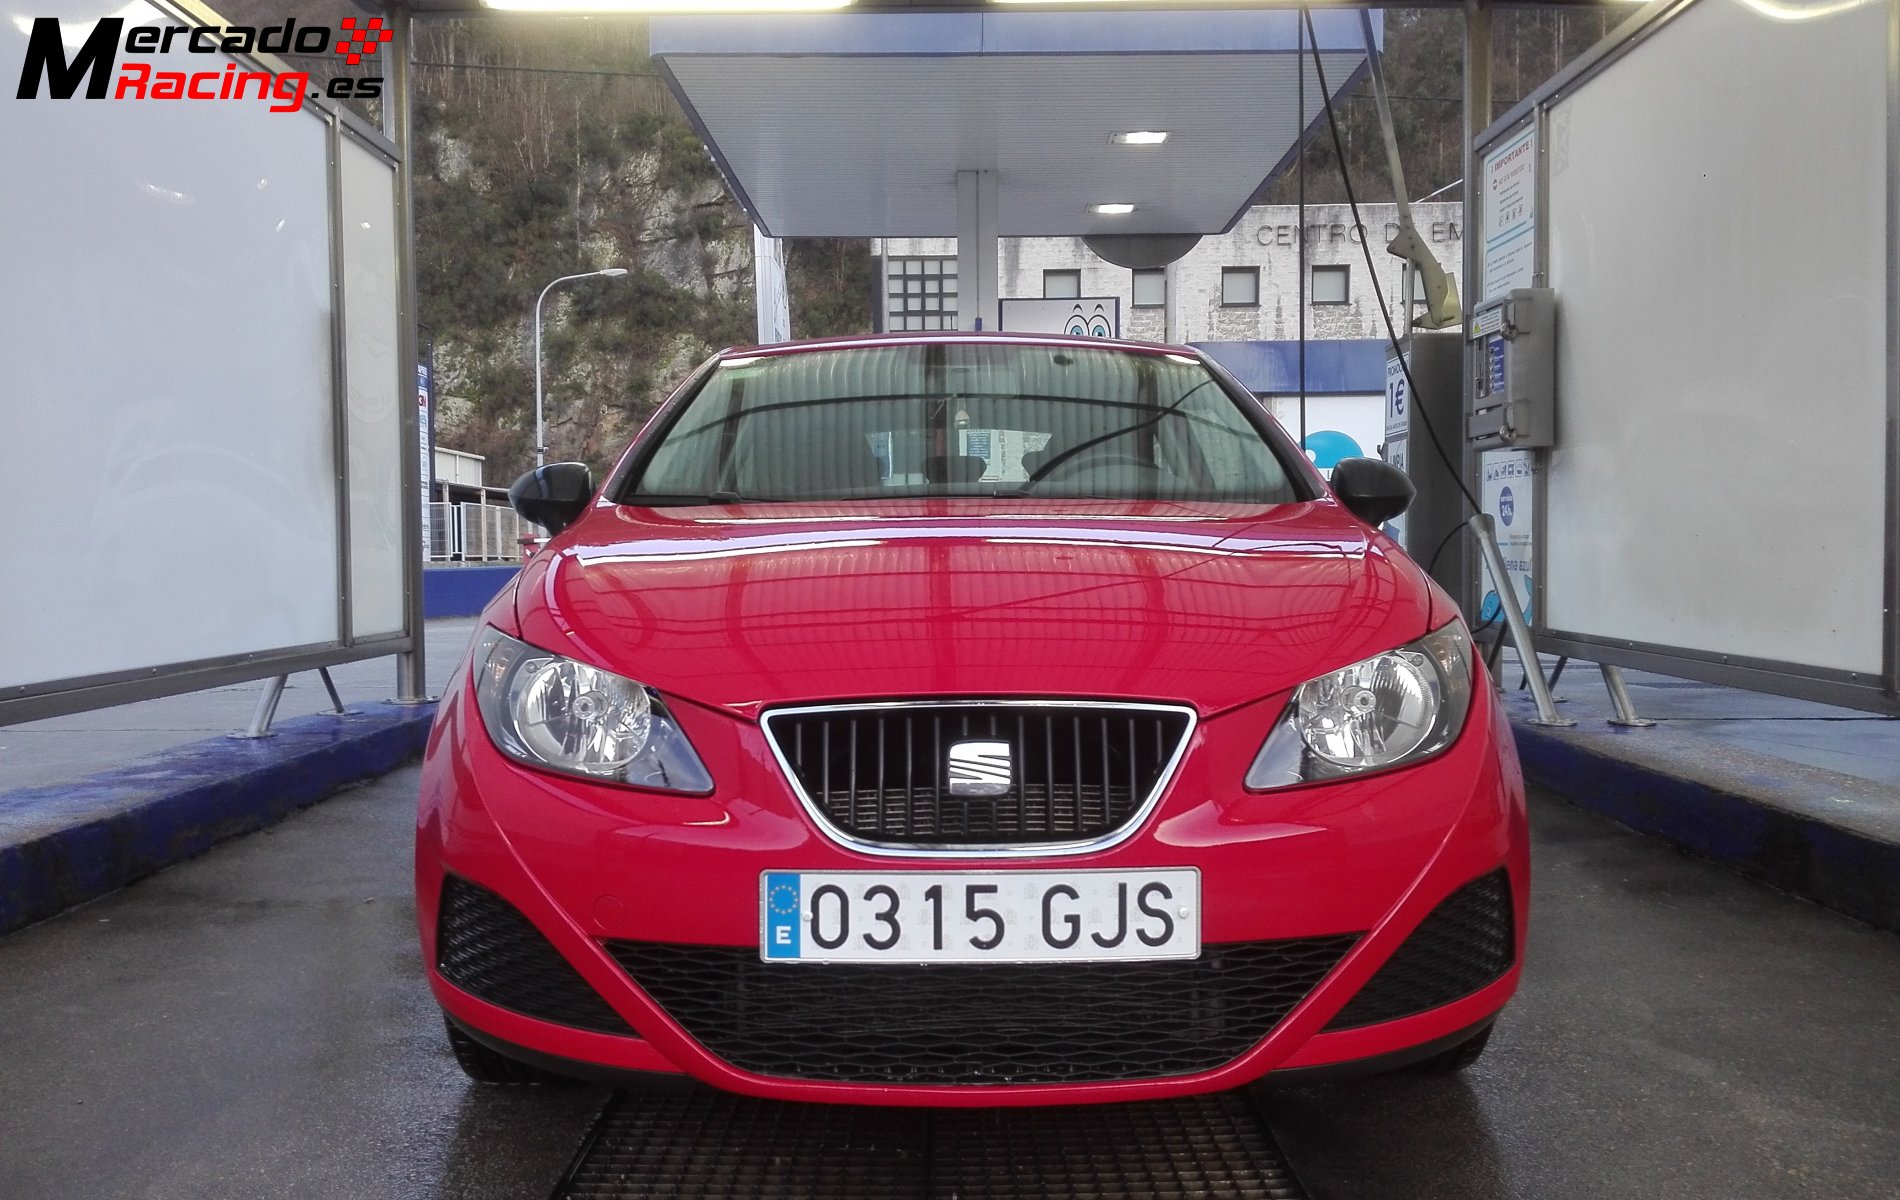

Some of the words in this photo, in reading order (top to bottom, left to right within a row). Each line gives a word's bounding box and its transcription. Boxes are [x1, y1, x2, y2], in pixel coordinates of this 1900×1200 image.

[1494, 140, 1530, 172] IMPORTANTE
[1256, 223, 1368, 247] CENTRO
[1432, 221, 1464, 243] EM
[1389, 378, 1405, 418] 1€
[809, 883, 1005, 951] 0315
[1041, 881, 1175, 948] GJS
[775, 925, 792, 945] E
